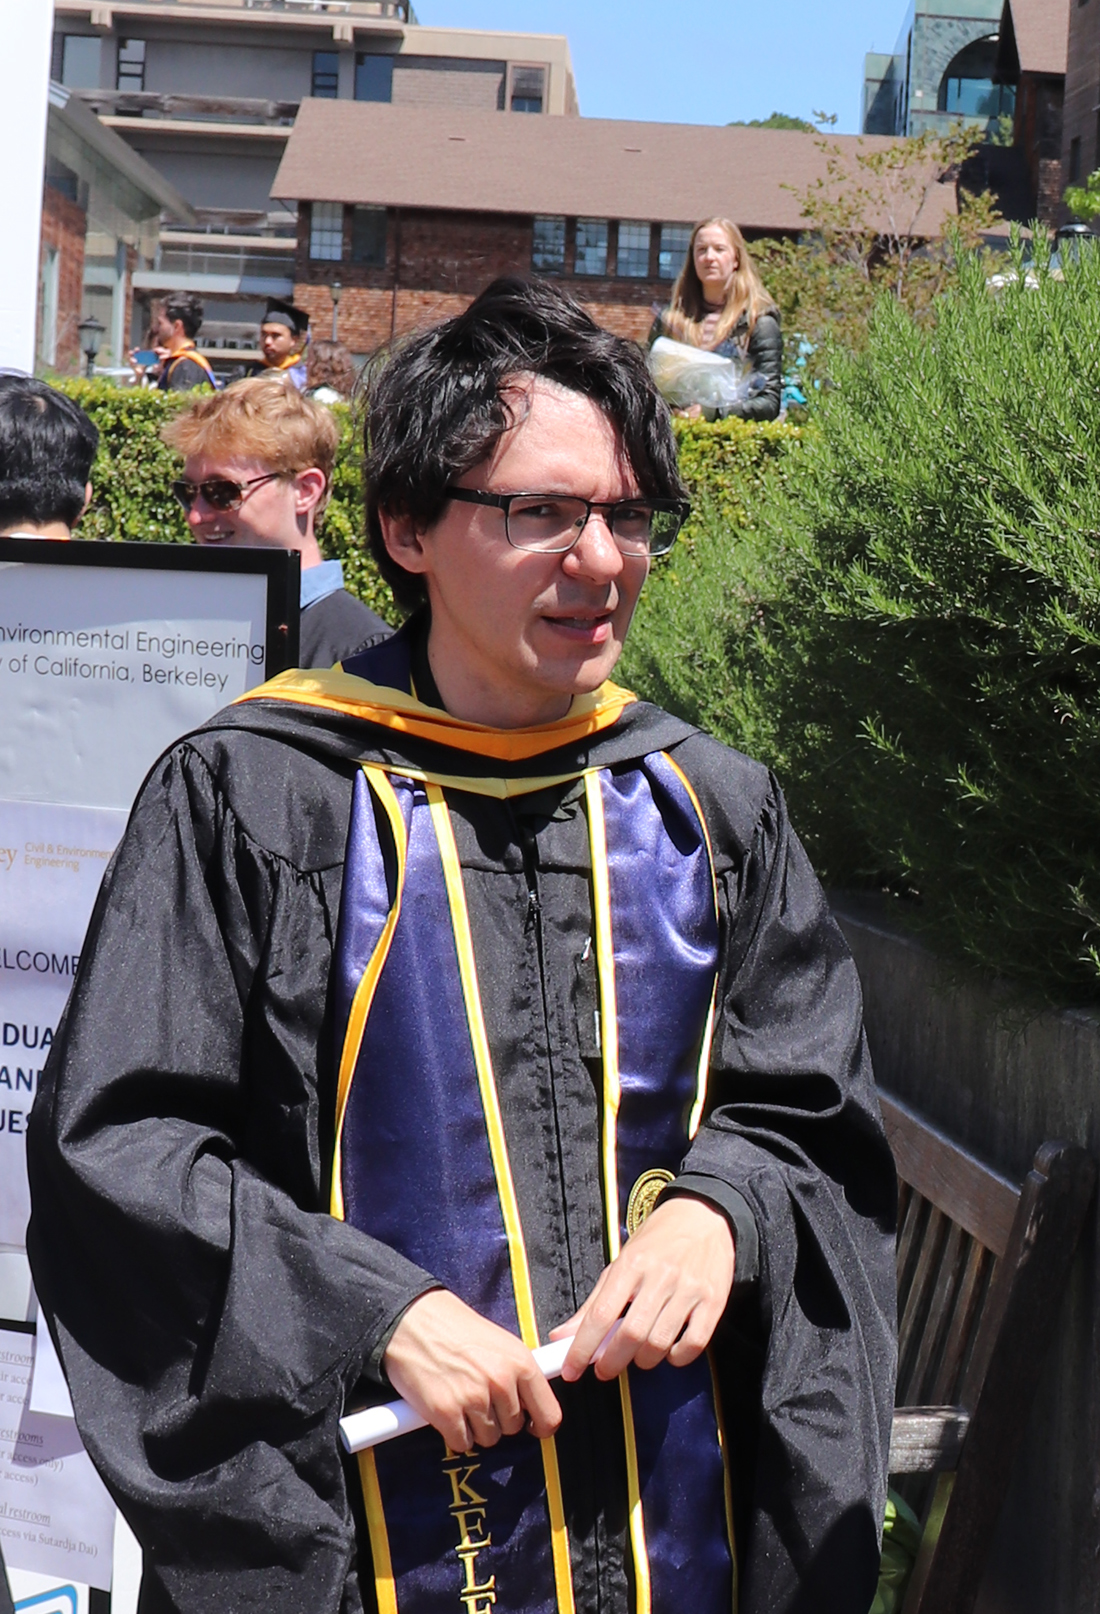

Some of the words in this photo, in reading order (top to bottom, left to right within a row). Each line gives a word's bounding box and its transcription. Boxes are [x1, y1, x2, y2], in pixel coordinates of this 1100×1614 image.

[136, 631, 265, 666] Engineering
[8, 654, 29, 674] of
[34, 655, 135, 684] California,
[142, 663, 229, 693] Berkeley
[24, 841, 45, 854] Civil
[47, 843, 54, 854] &
[24, 854, 80, 873] Engineering
[9, 1507, 51, 1524] restroom
[23, 1531, 37, 1542] via
[39, 1532, 76, 1553] Sutardja
[78, 1540, 98, 1559] Dai)
